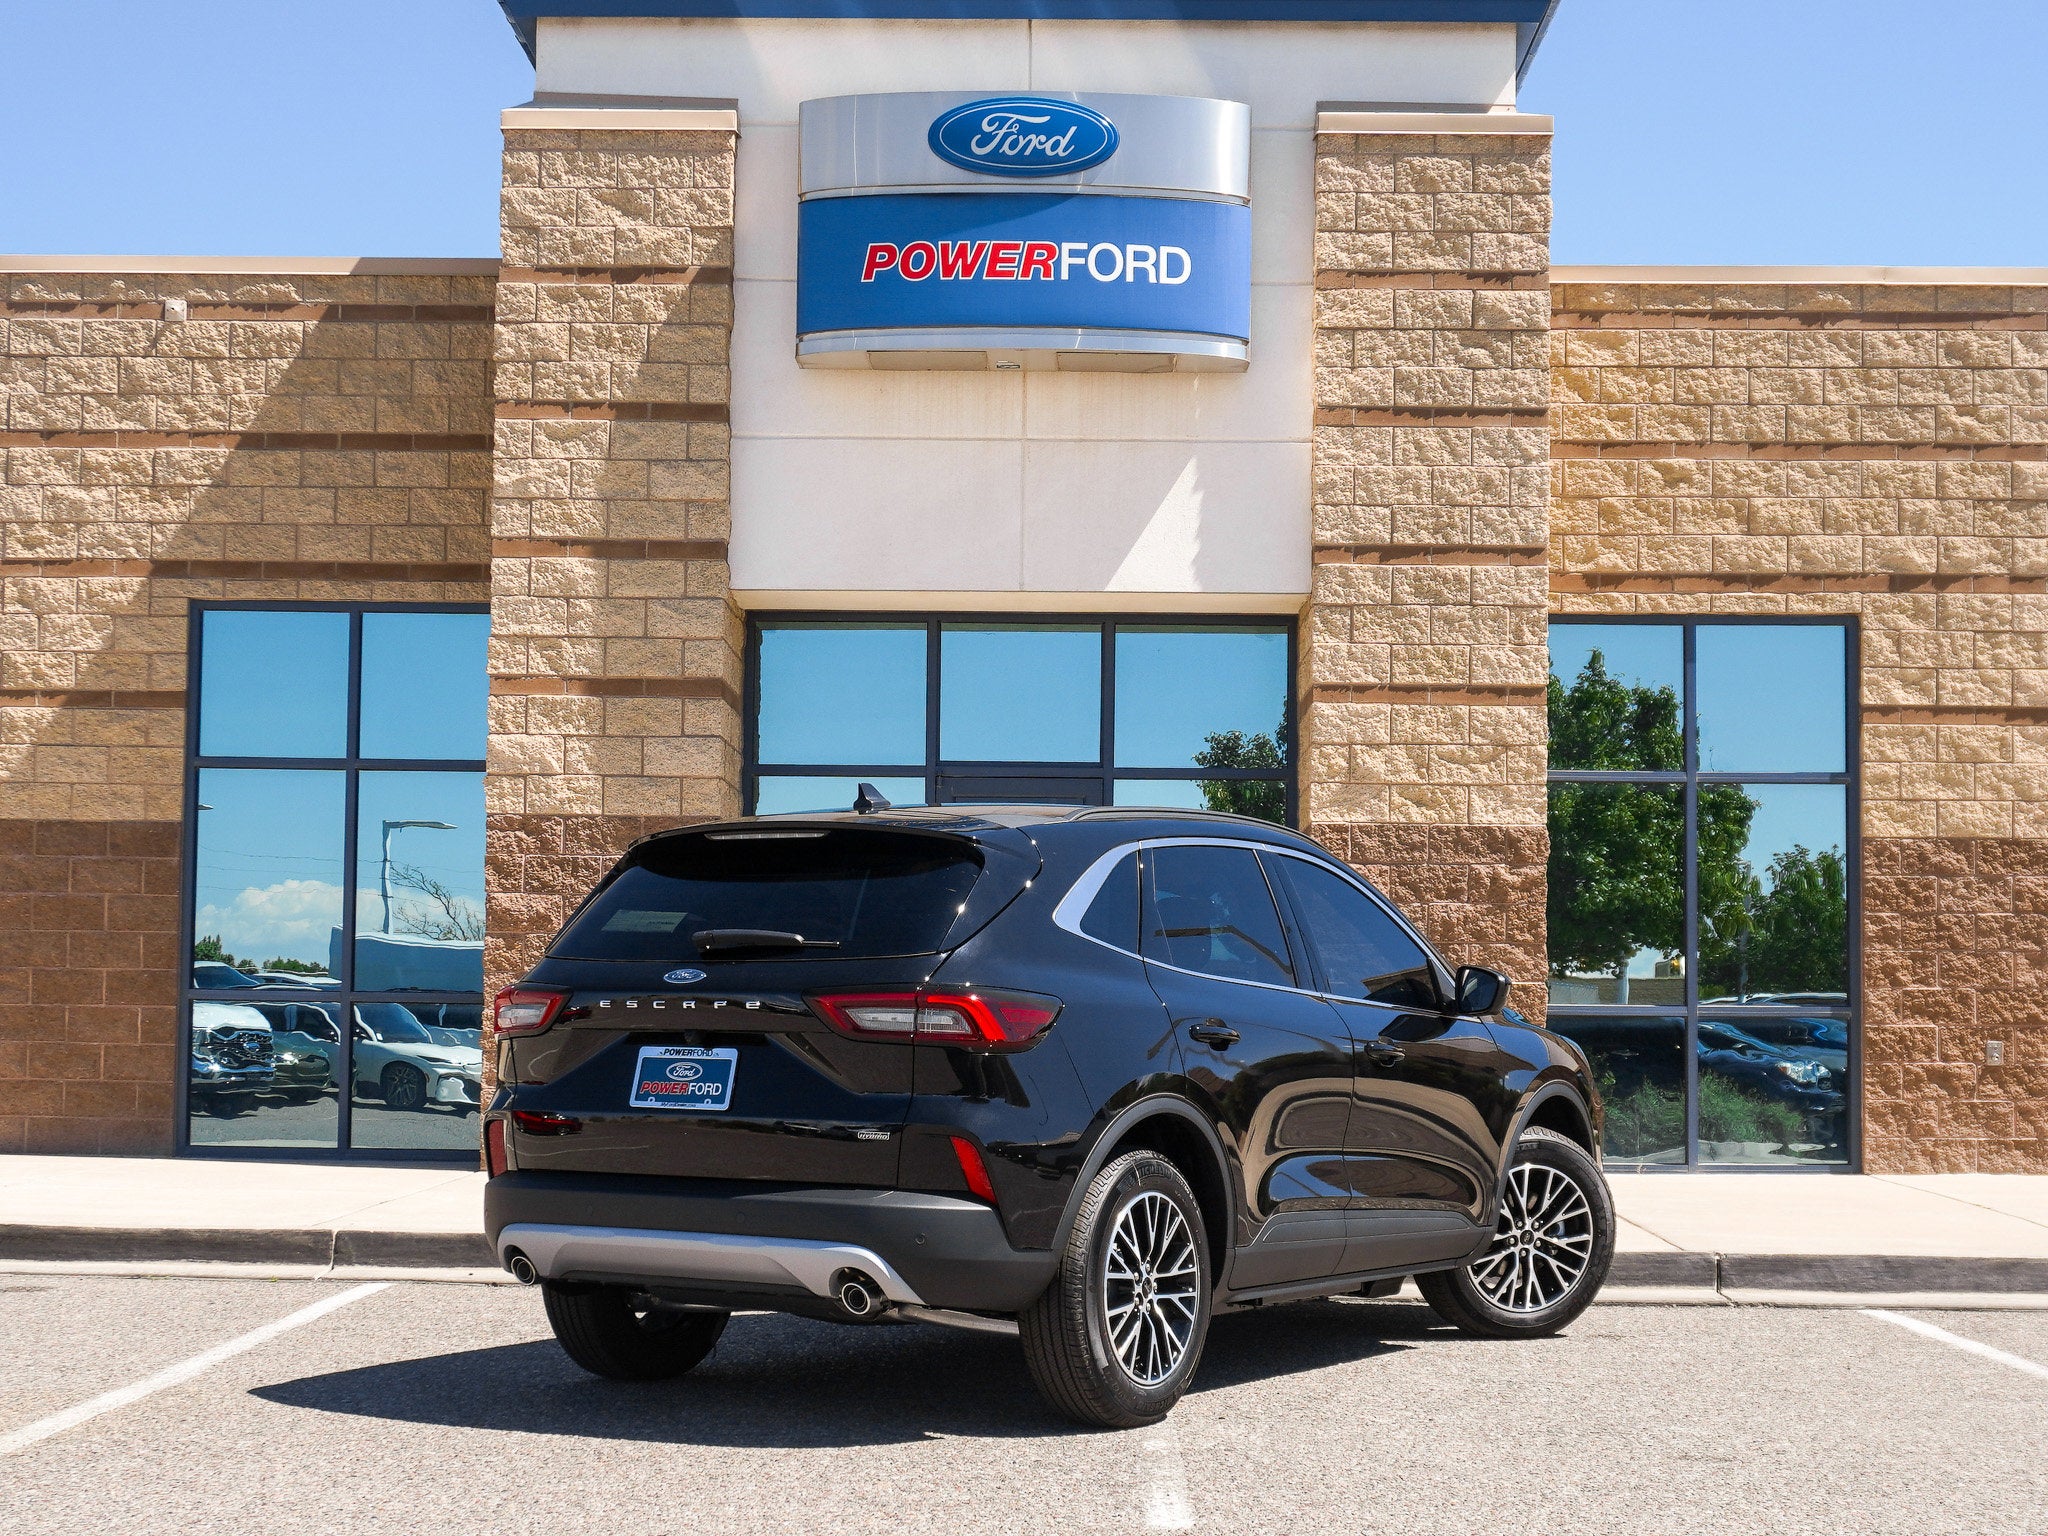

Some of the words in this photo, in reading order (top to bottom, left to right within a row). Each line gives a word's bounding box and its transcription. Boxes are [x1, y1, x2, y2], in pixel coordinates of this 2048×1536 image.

[970, 112, 1077, 158] Ford
[599, 1000, 761, 1009] ESCAPE
[673, 1064, 696, 1077] Ford
